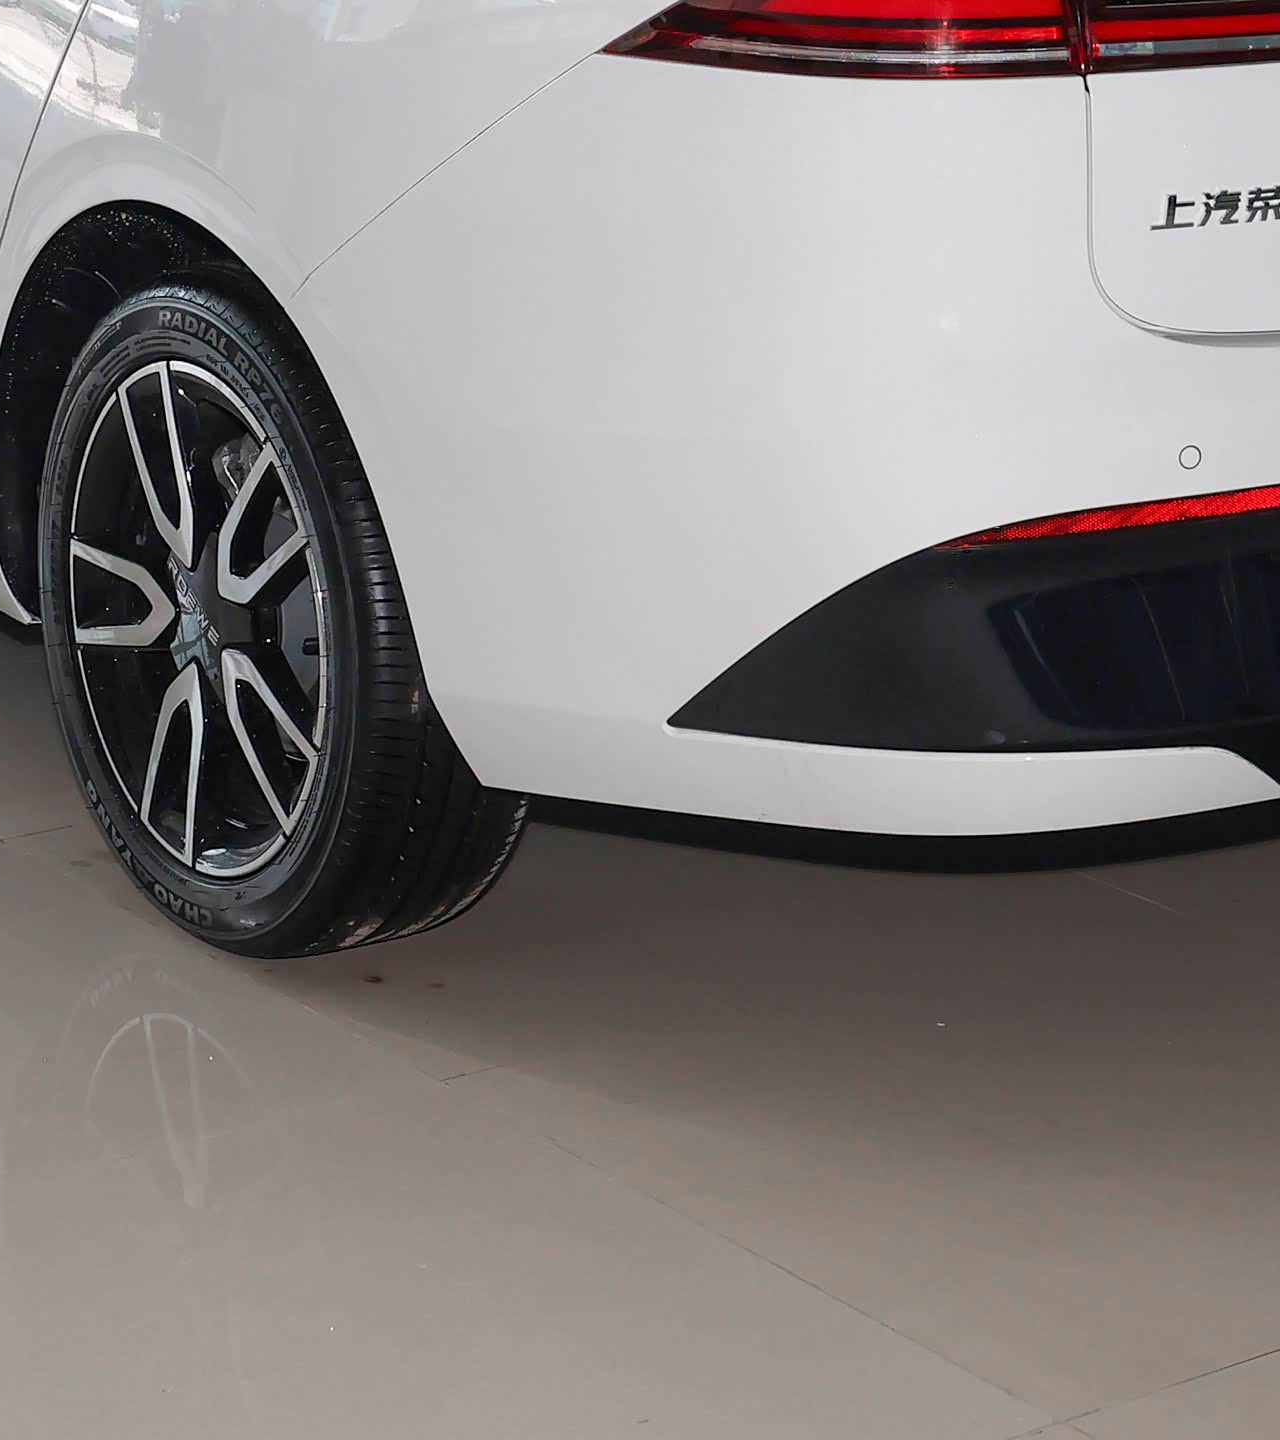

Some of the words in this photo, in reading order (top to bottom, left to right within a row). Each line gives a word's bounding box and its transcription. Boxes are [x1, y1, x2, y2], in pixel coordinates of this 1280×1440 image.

[158, 311, 229, 356] RADIAL
[168, 557, 221, 647] ROEWE
[153, 883, 214, 927] CHAO
